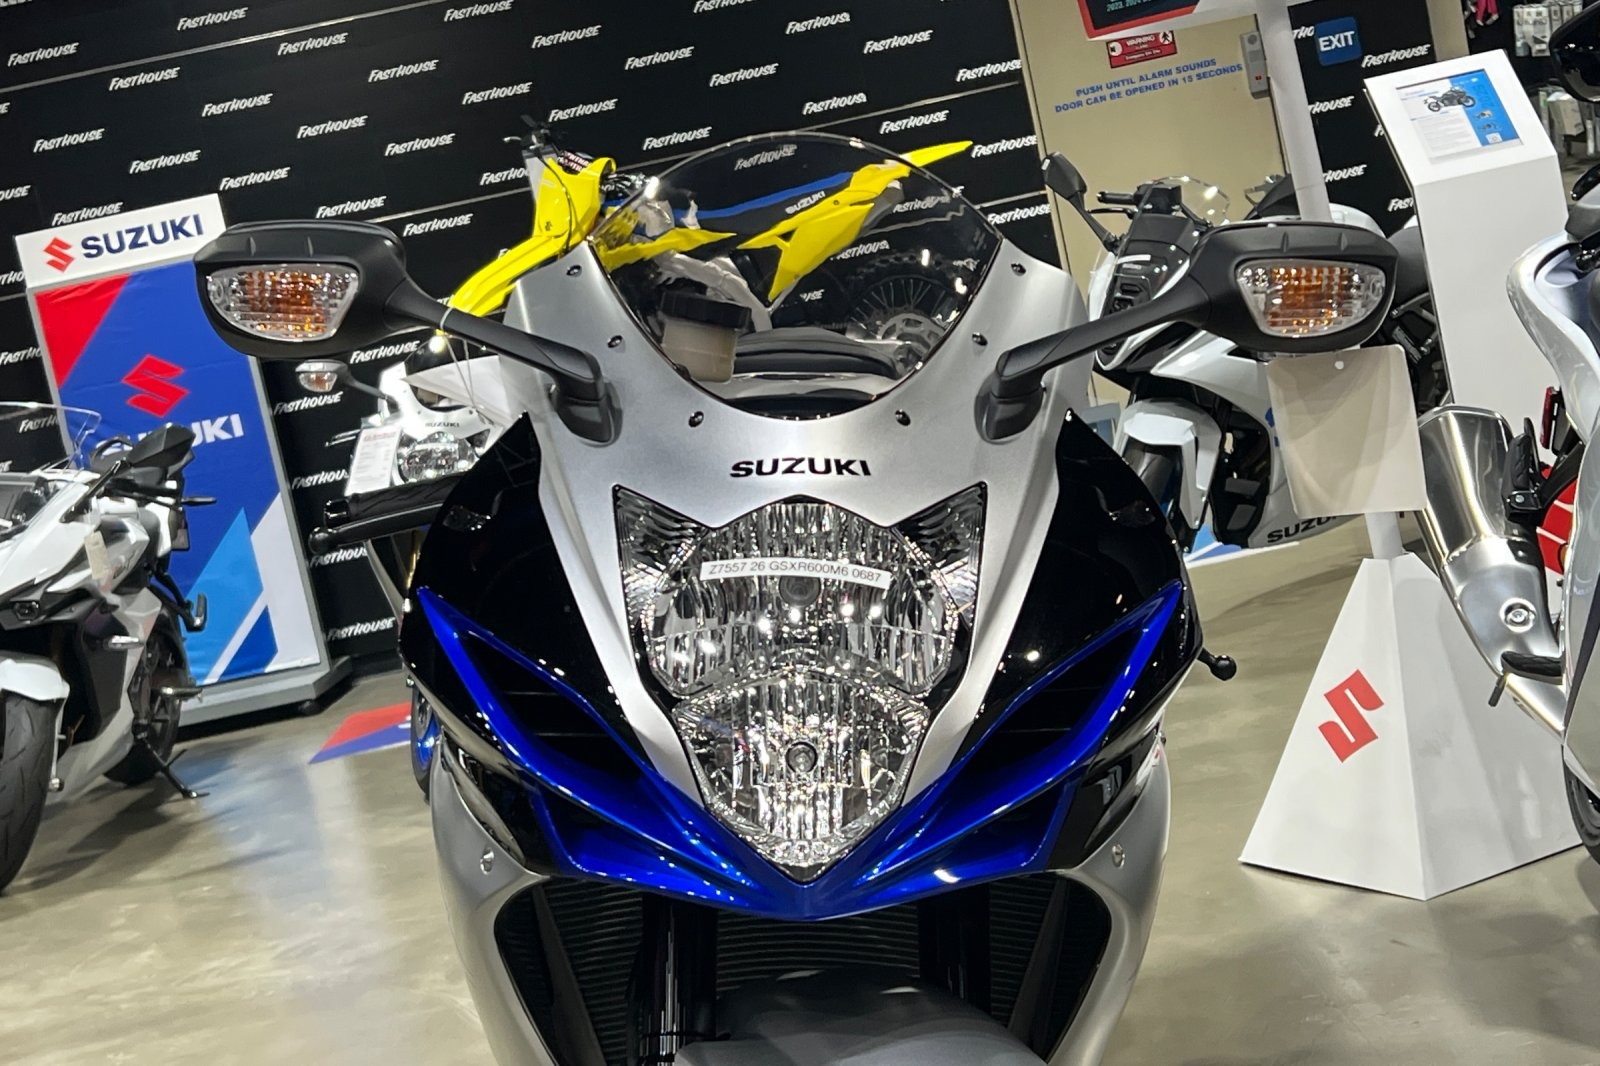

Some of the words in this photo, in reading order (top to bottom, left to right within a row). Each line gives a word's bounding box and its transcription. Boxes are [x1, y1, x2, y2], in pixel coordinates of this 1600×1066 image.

[177, 7, 248, 30] FASTHOUSE
[444, 0, 513, 21] FASTHOUSE
[278, 32, 348, 55] FASTHOUSE
[532, 25, 601, 48] FASTHOUSE
[864, 30, 933, 54] FASTHOUSE
[1319, 31, 1355, 51] EXIT
[8, 43, 79, 66] FASTHOUSE
[625, 47, 694, 70] FASTHOUSE
[1362, 44, 1431, 68] FASTHOUSE
[109, 67, 180, 90] FASTHOUSE
[368, 60, 439, 82] FASTHOUSE
[710, 63, 778, 87] FASTHOUSE
[956, 59, 1022, 82] FASTHOUSE
[1076, 84, 1103, 97] PUSH
[1106, 77, 1136, 90] UNTIL
[1138, 69, 1173, 82] ALARM
[1176, 58, 1217, 74] SOUNDS
[462, 82, 532, 104] FASTHOUSE
[1055, 100, 1083, 113] DOOR
[1085, 94, 1107, 106] CAN
[1109, 91, 1123, 101] BE
[1125, 81, 1165, 97] OPENED
[1168, 78, 1179, 87] IN
[1183, 75, 1193, 84] 15
[1195, 63, 1243, 80] SECONDS
[202, 93, 273, 117] FASTHOUSE
[549, 99, 617, 122] FASTHOUSE
[297, 116, 368, 139] FASTHOUSE
[880, 110, 949, 134] FASTHOUSE
[34, 129, 104, 152] FASTHOUSE
[385, 133, 455, 156] FASTHOUSE
[643, 127, 712, 150] FASTHOUSE
[971, 134, 1037, 158] FASTHOUSE
[130, 150, 201, 174] FASTHOUSE
[220, 167, 290, 190] FASTHOUSE
[480, 167, 531, 185] FASTHO
[52, 202, 123, 226] FASTHOUSE
[316, 196, 387, 219] FASTHOUSE
[988, 203, 1050, 225] FASTHOUSE
[80, 213, 204, 259] SUZUKI
[403, 213, 473, 236] FASTHOUSE
[350, 341, 420, 364] FASTHOUSE
[729, 457, 871, 478] SUZUKI
[1267, 516, 1337, 543] SUZU
[708, 560, 746, 576] Z7557
[750, 560, 766, 572] 26
[769, 561, 849, 577] GSXR600M6
[851, 569, 882, 583] 0687
